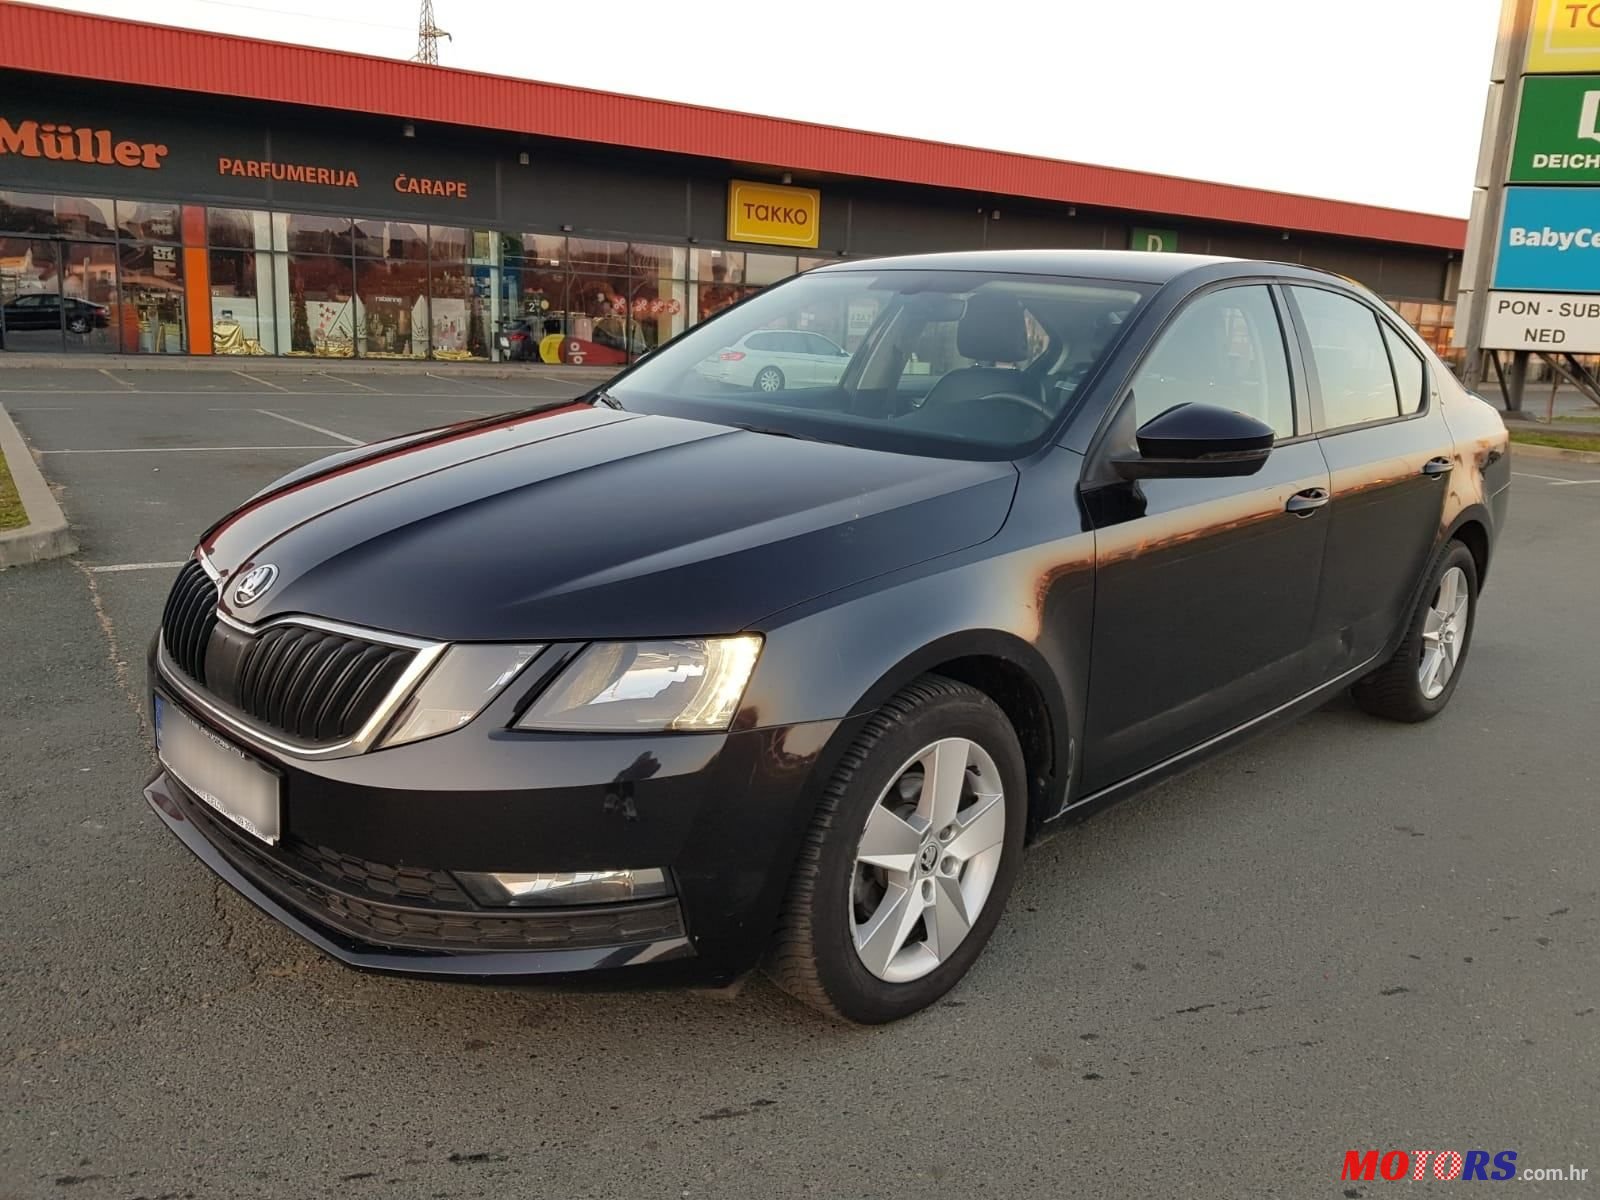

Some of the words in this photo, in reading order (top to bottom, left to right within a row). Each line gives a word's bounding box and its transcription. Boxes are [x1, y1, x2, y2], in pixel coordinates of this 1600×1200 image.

[0, 117, 168, 169] Müller
[218, 157, 360, 188] PARFUMERIJA
[1532, 153, 1600, 169] DEICH
[394, 173, 468, 198] ČARAPE
[1509, 226, 1600, 251] BabyCe
[1498, 300, 1541, 316] PON
[1558, 302, 1600, 318] SUB
[1524, 327, 1566, 344] NED
